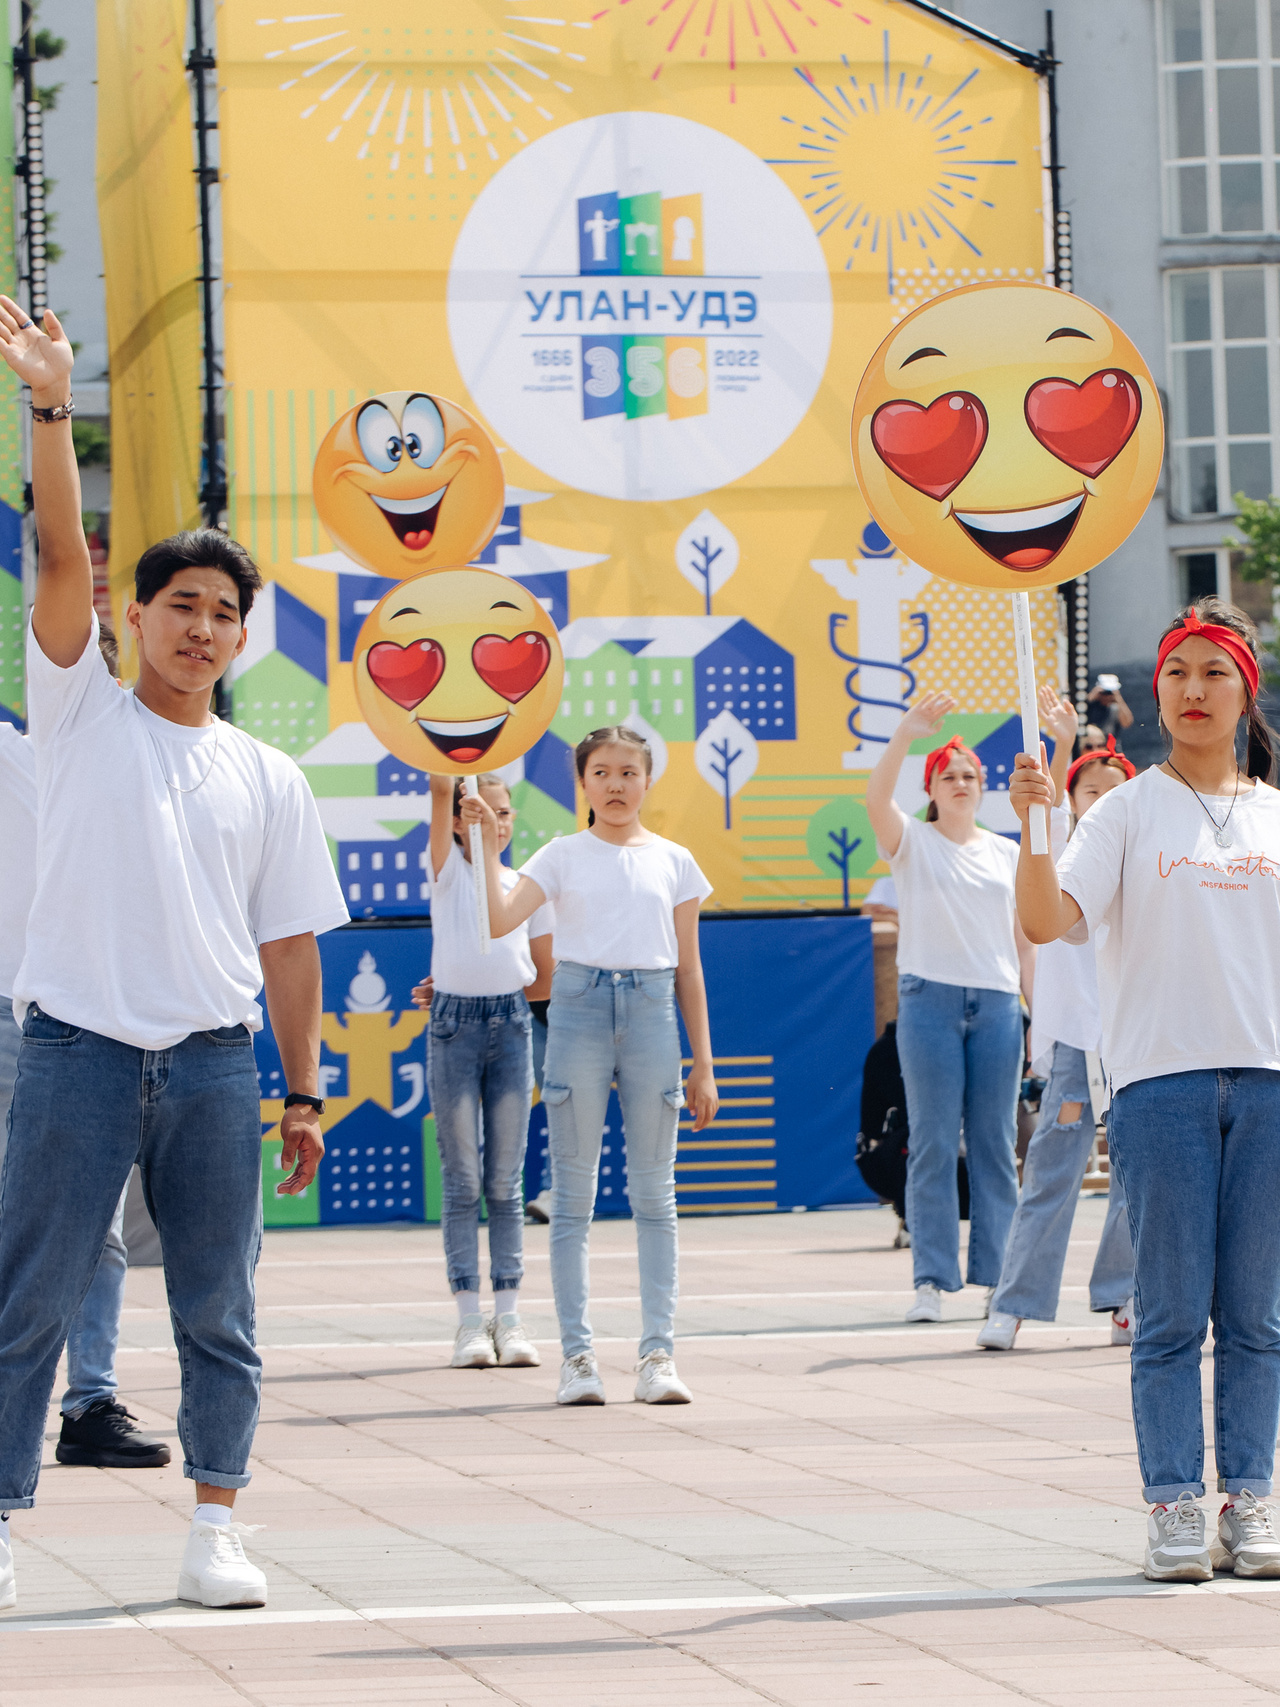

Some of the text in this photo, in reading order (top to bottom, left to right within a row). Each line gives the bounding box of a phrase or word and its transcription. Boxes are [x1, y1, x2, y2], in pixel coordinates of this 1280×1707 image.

[525, 290, 758, 329] УЛАН-УДЭ
[583, 346, 707, 398] 356
[714, 349, 760, 367] 2022
